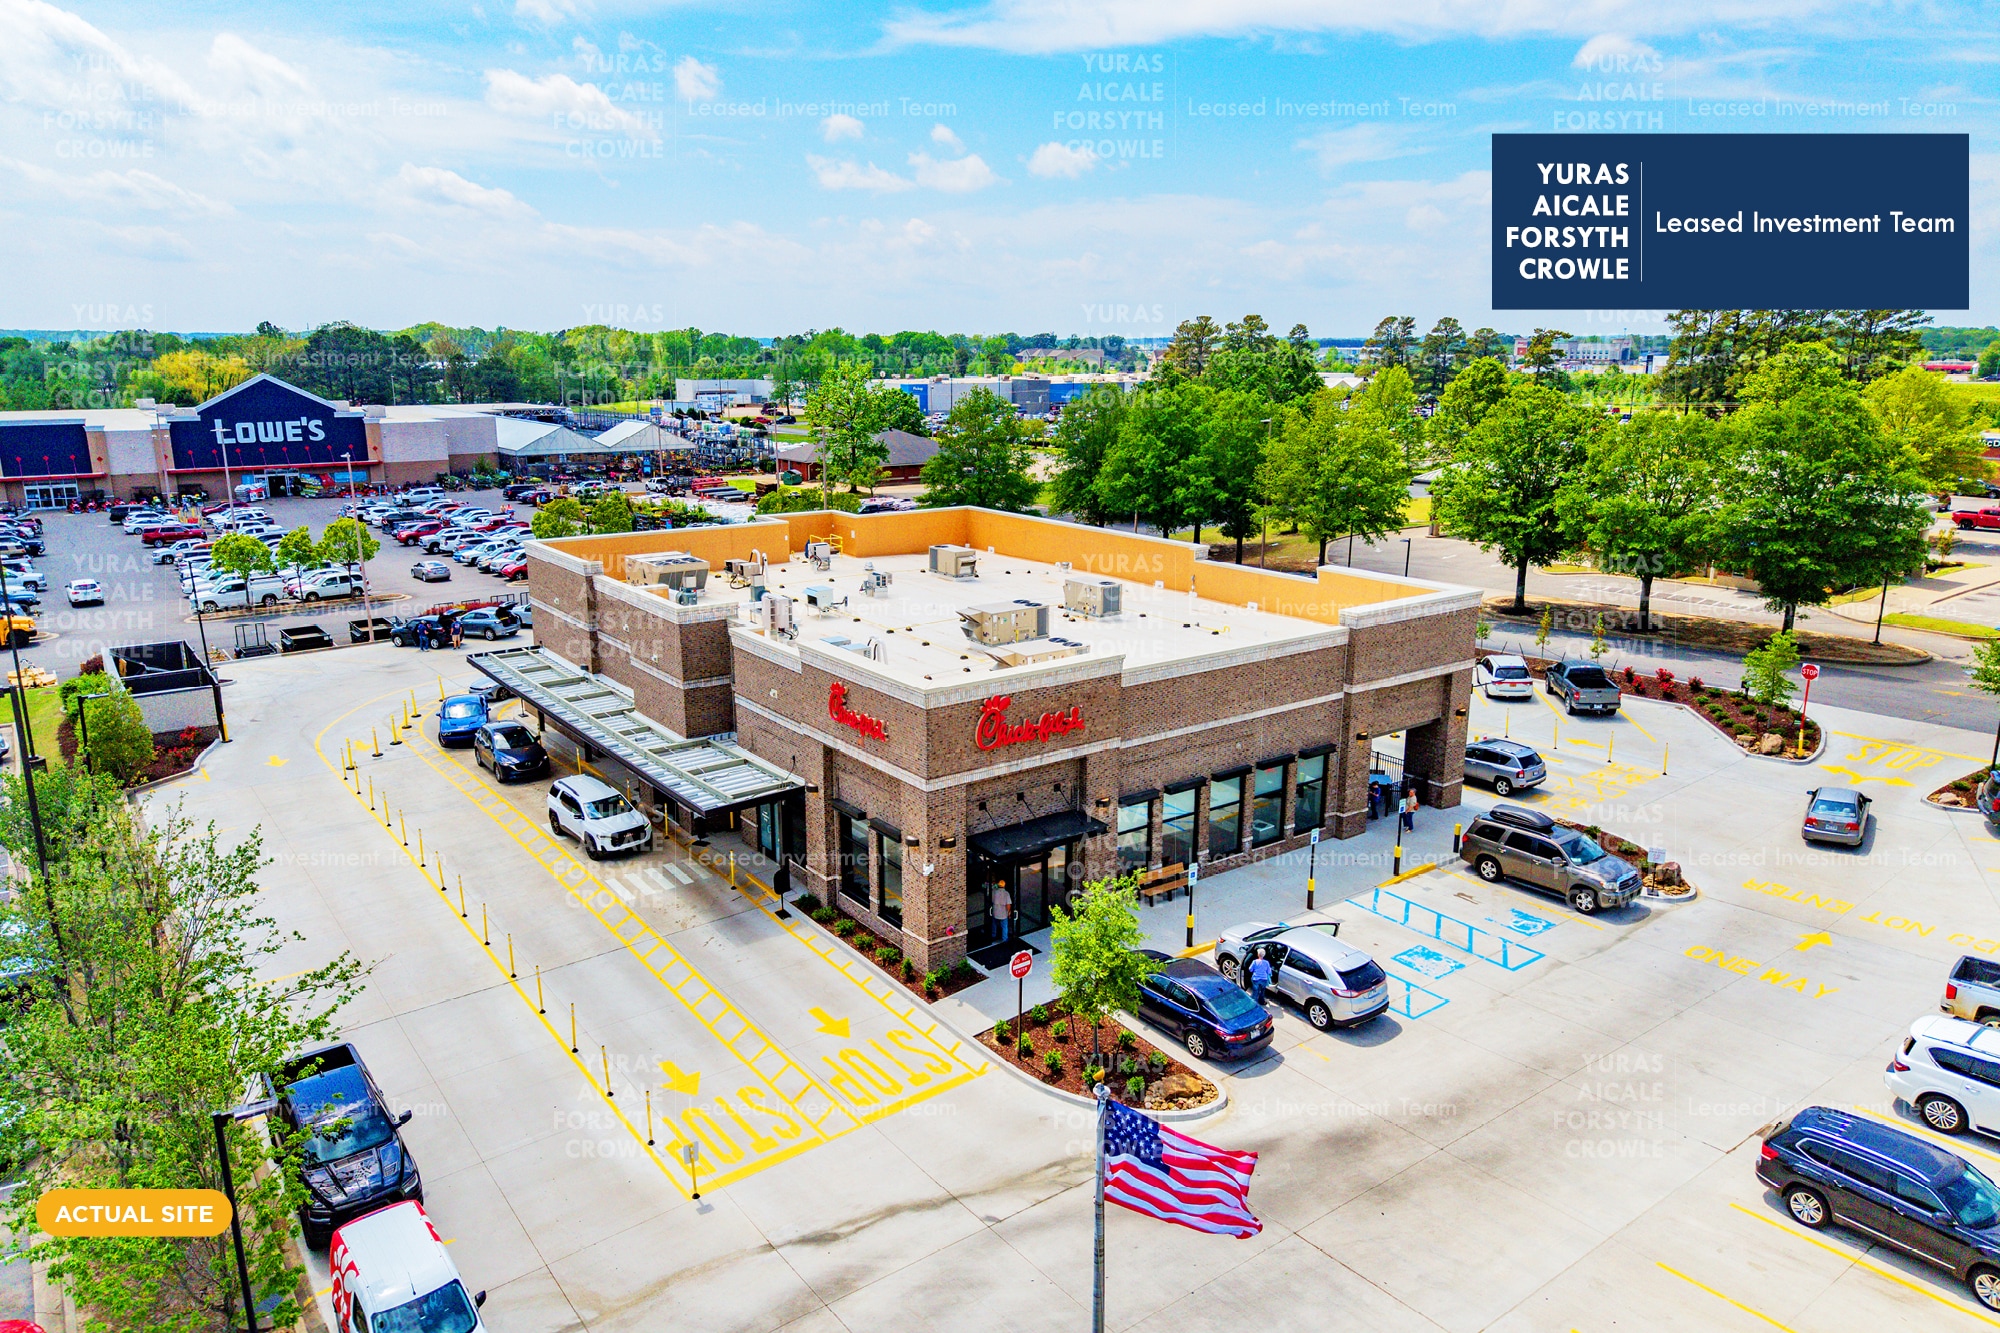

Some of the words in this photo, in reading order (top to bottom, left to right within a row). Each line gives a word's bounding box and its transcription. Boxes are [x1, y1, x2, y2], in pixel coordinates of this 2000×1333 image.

[214, 417, 325, 444] LOWE'S
[1802, 668, 1818, 676] STOP
[976, 695, 1086, 750] Chick-fil-A
[1845, 743, 1944, 772] STOP
[1741, 877, 1855, 914] ENTER
[1858, 911, 1936, 937] NOT
[1684, 945, 1761, 975] ONE
[1758, 967, 1841, 999] WAY
[820, 1029, 953, 1106] STOP
[661, 1085, 803, 1178] STOP
